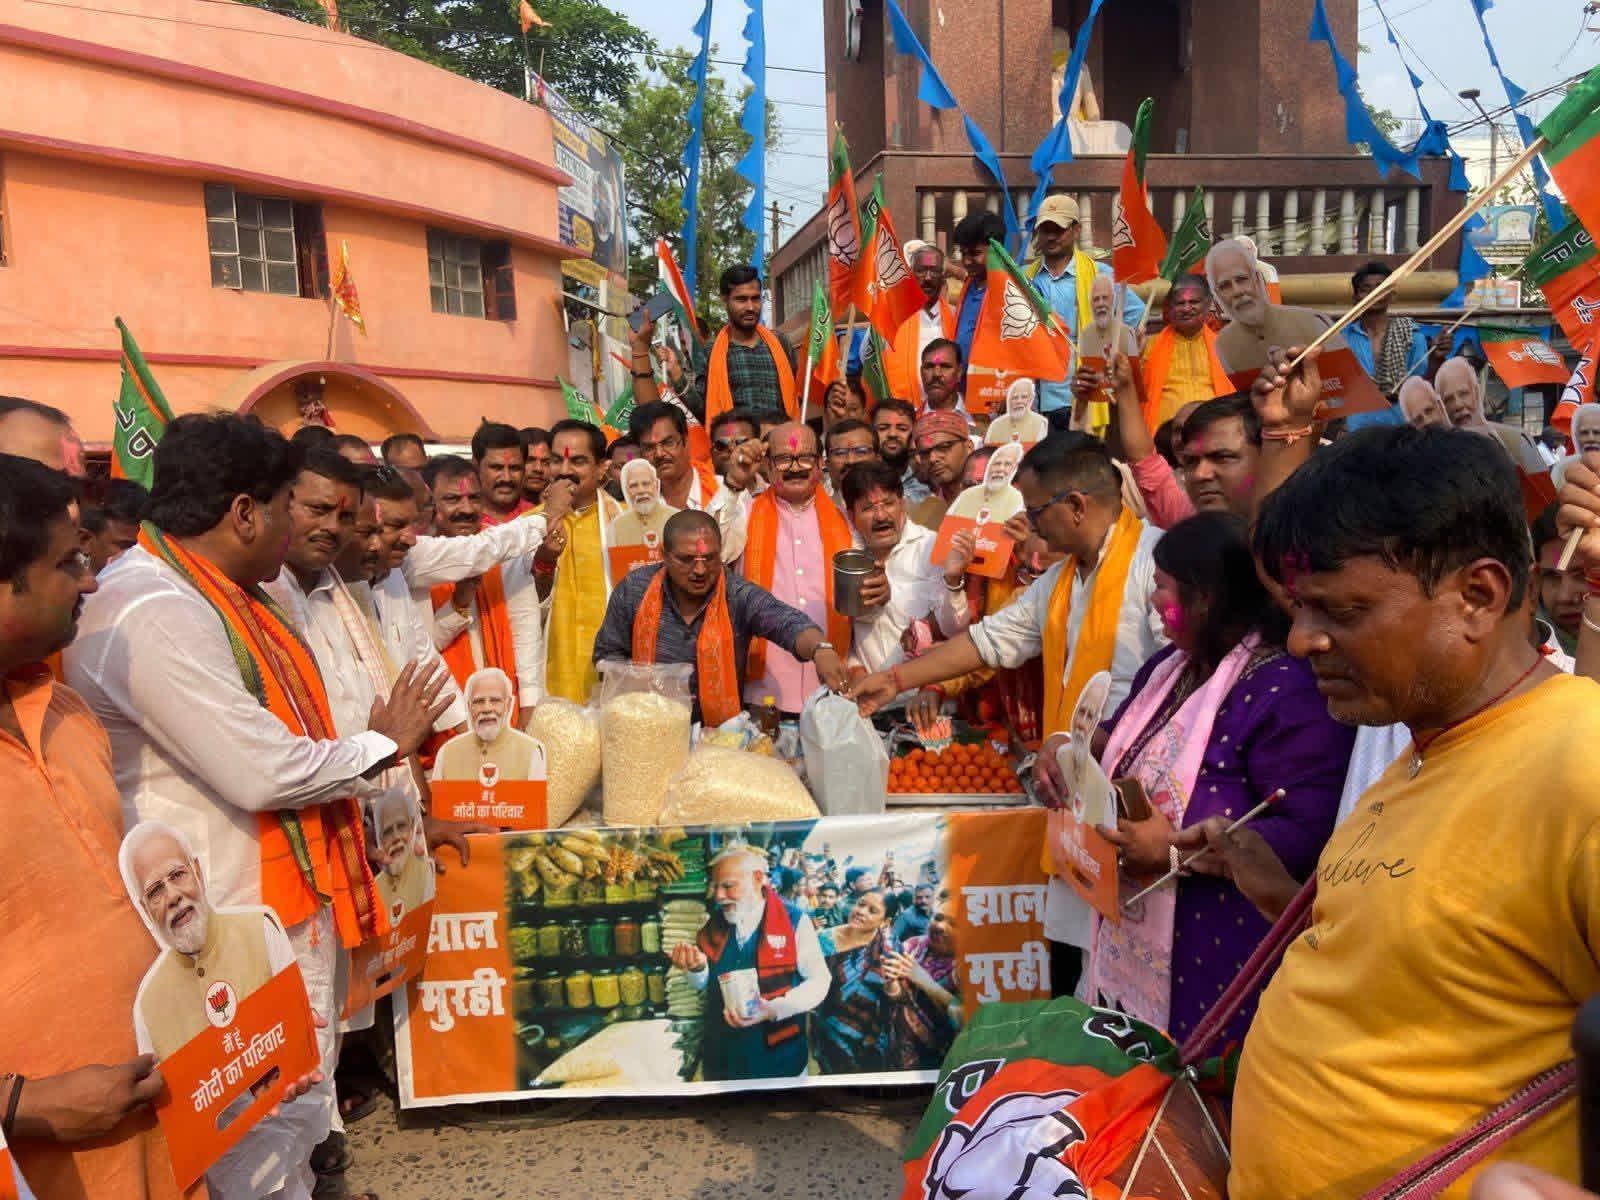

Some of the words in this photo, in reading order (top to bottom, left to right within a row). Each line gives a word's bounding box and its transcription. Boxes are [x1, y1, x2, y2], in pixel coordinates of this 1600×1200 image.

[960, 884, 1048, 927] झाल
[417, 967, 507, 1033] मुरही
[191, 1067, 225, 1112] मोदी
[223, 1055, 244, 1085] का
[242, 1021, 286, 1068] परिवार
